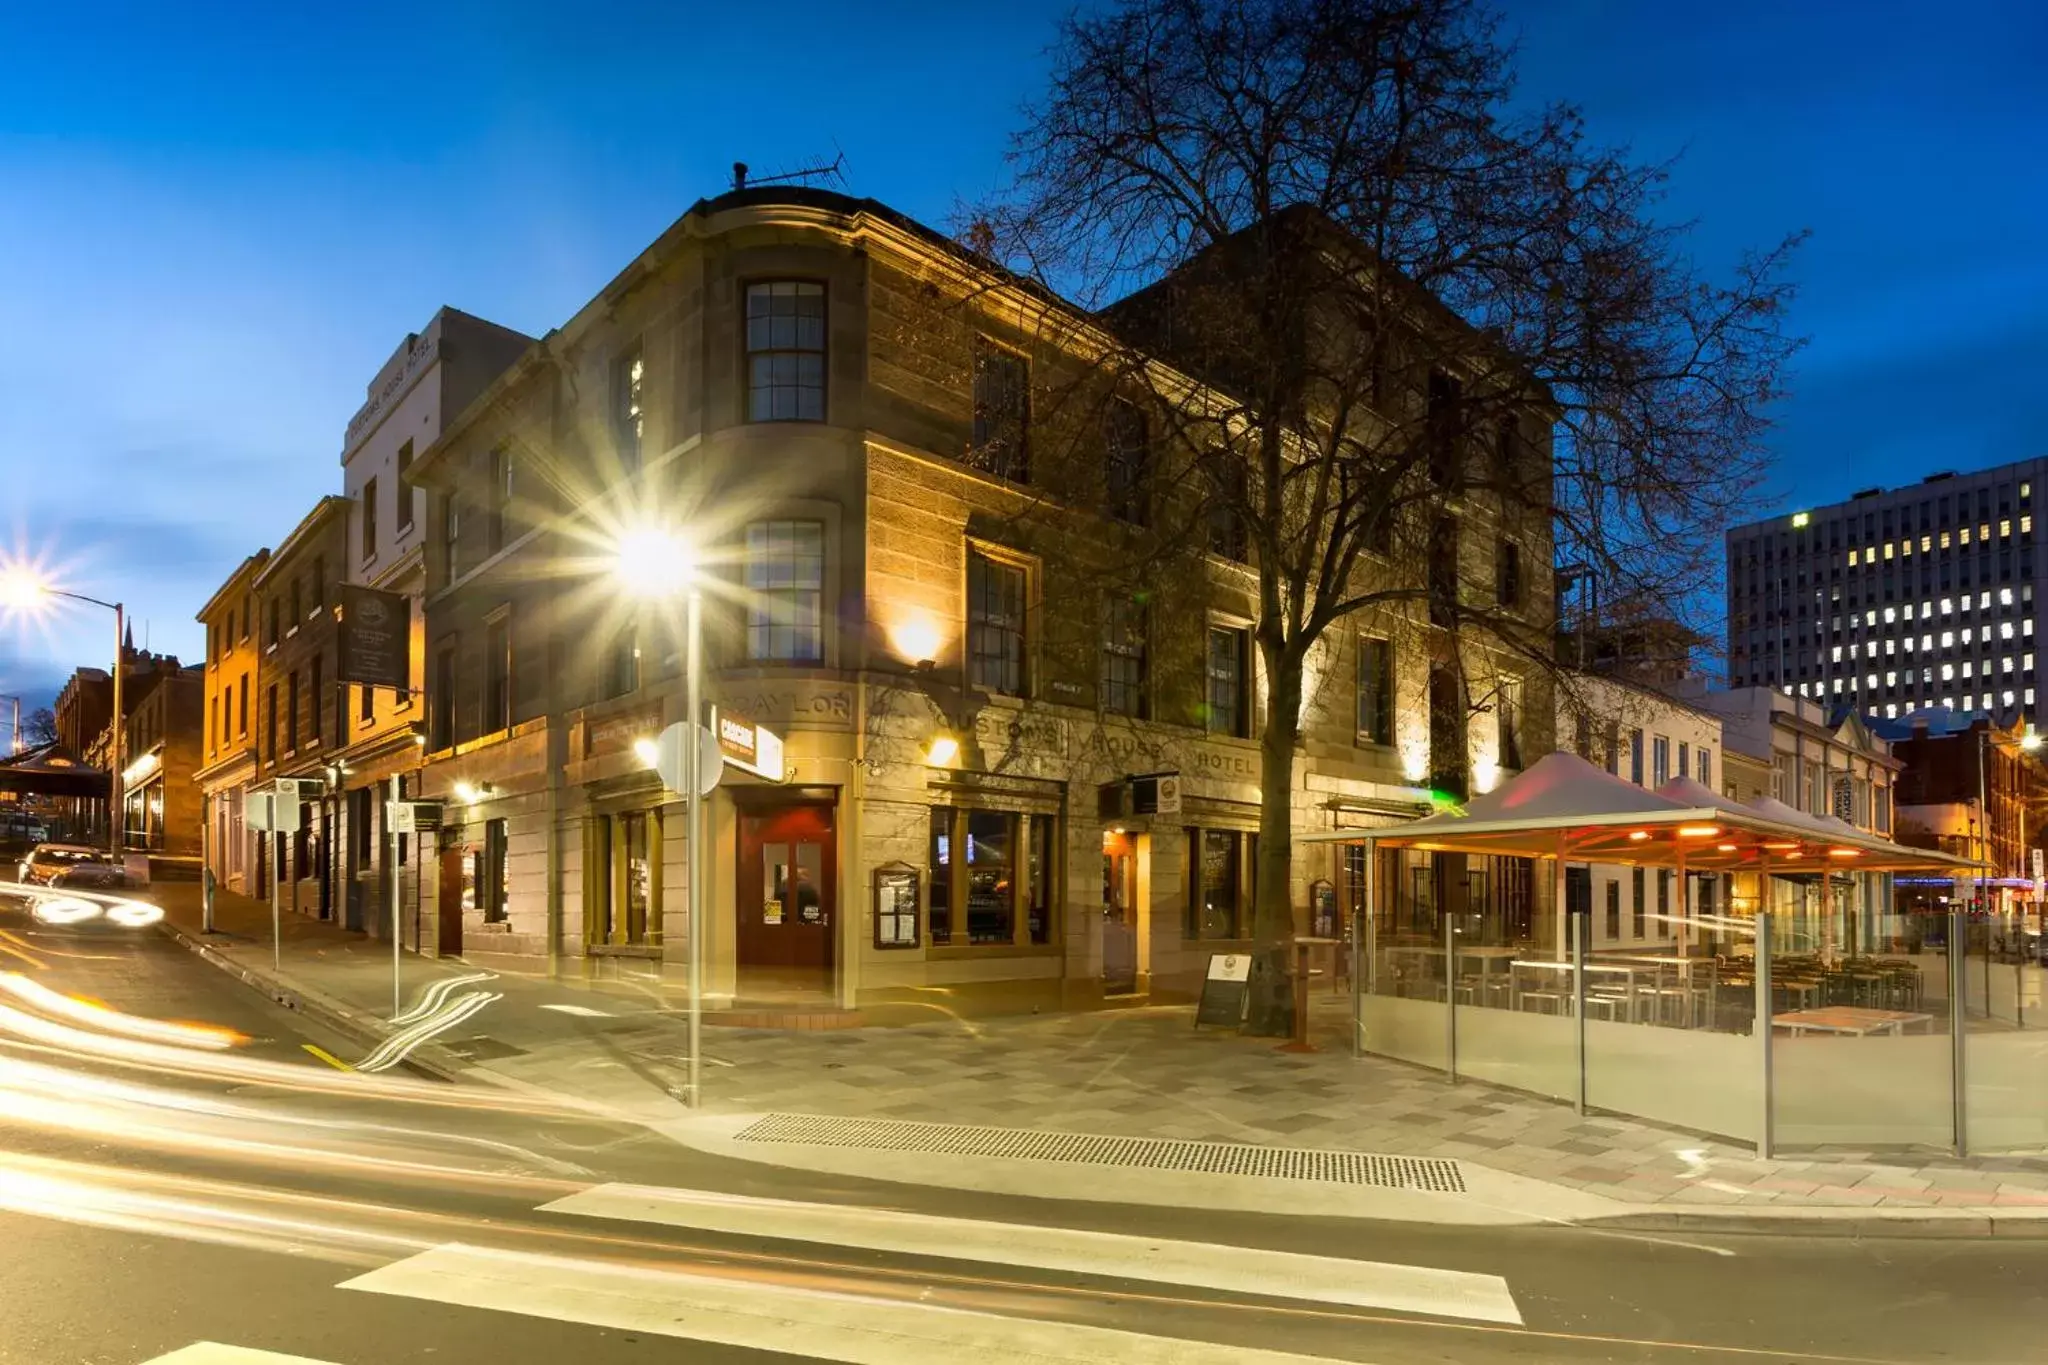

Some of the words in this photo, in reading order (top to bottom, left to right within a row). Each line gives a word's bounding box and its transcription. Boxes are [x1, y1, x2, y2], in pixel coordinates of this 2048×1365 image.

[721, 717, 755, 750] CASCADE
[1093, 732, 1162, 759] HOUSE
[1198, 752, 1255, 775] HOTEL
